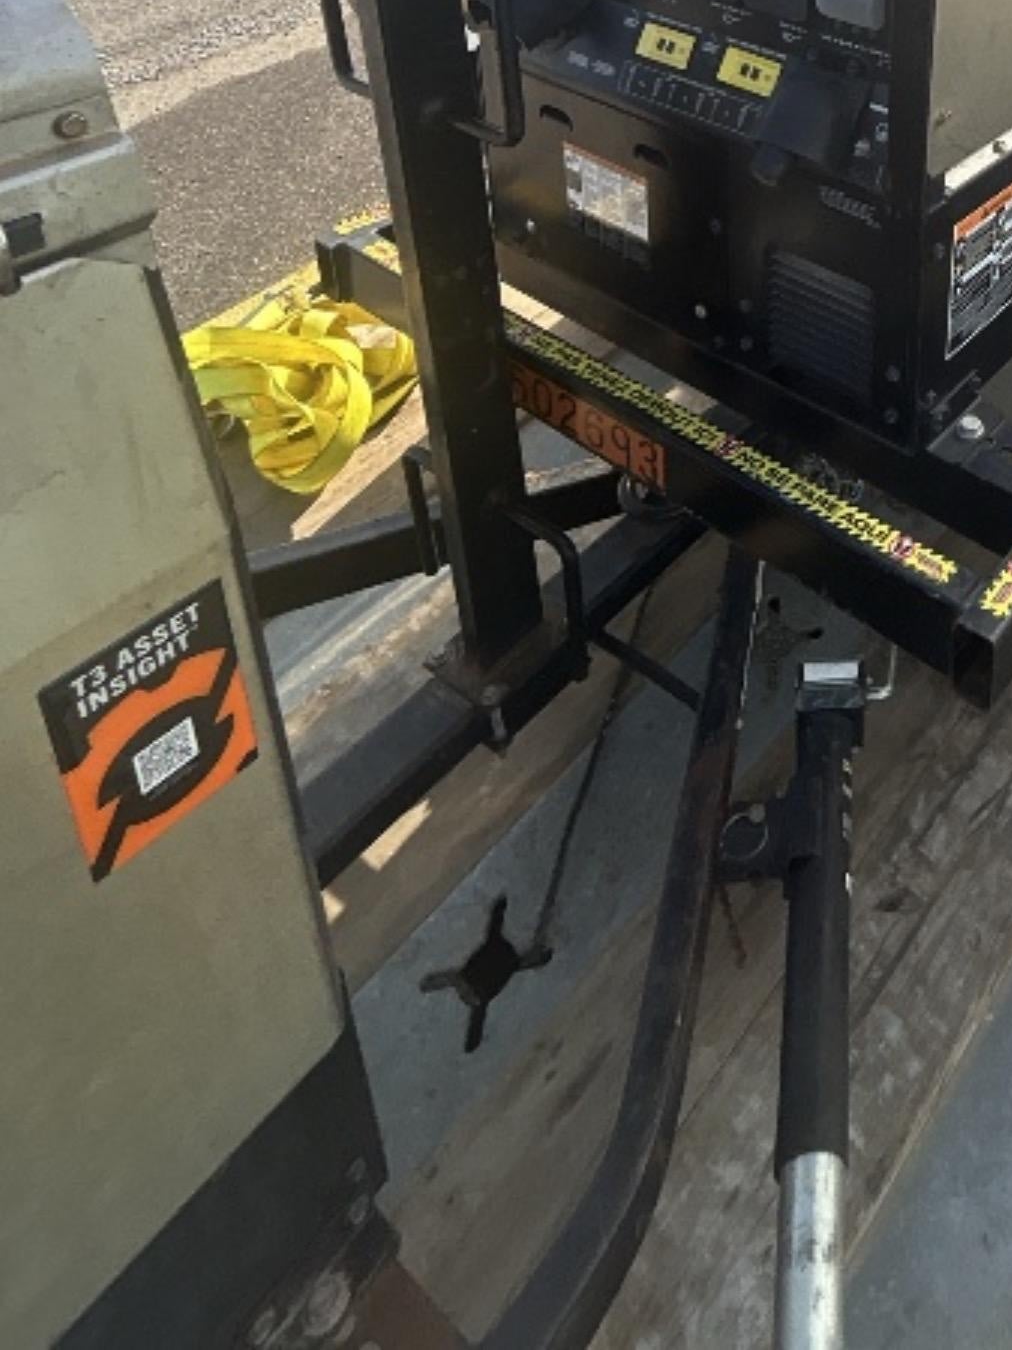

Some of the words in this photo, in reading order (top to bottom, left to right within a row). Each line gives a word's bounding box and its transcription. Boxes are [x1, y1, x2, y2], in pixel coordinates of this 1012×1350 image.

[70, 665, 108, 697] T3
[116, 602, 199, 671] ASSET
[76, 631, 190, 719] INSIGHT
